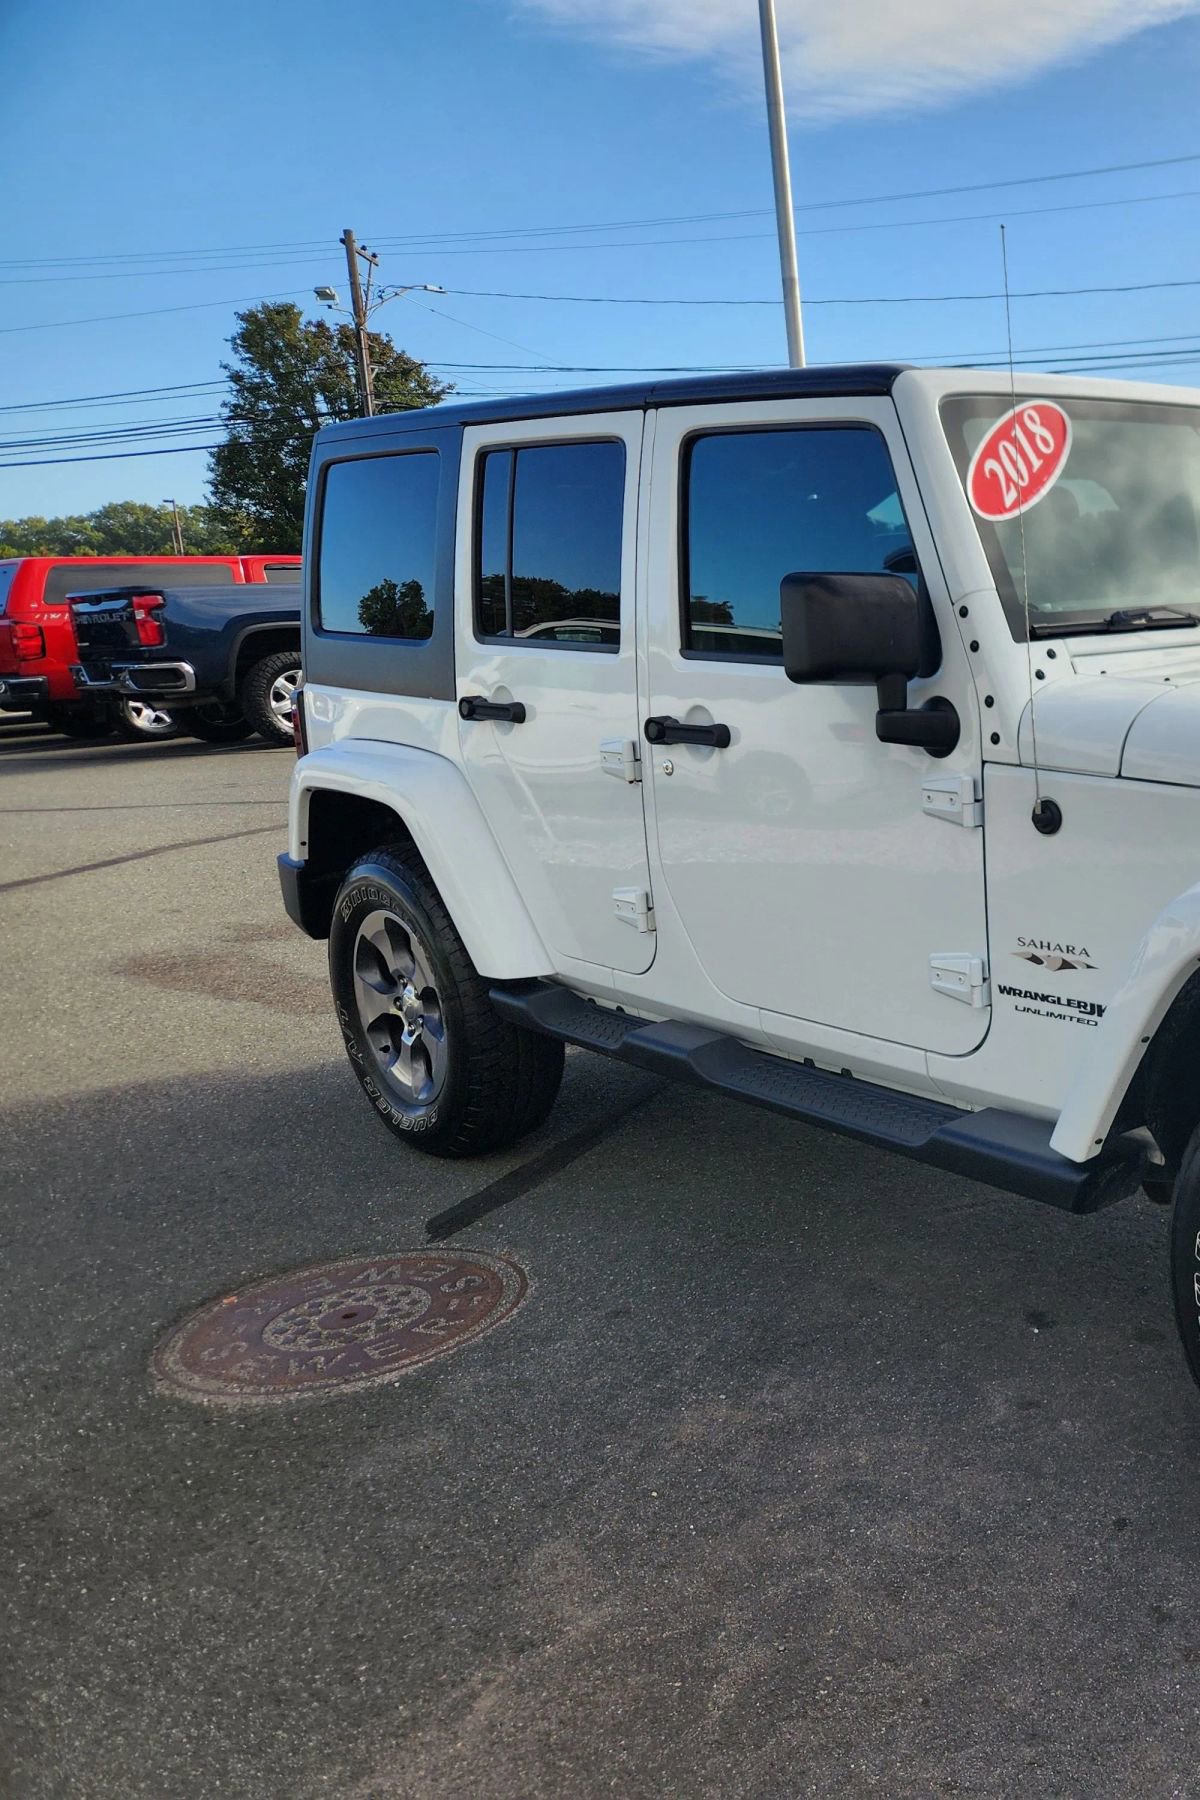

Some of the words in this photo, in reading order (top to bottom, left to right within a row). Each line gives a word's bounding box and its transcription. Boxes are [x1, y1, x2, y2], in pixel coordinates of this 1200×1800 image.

[983, 408, 1056, 509] 2018
[1017, 936, 1091, 958] SAHARA
[997, 983, 1088, 1011] WRANGLER
[1014, 1004, 1099, 1027] UNLIMITED
